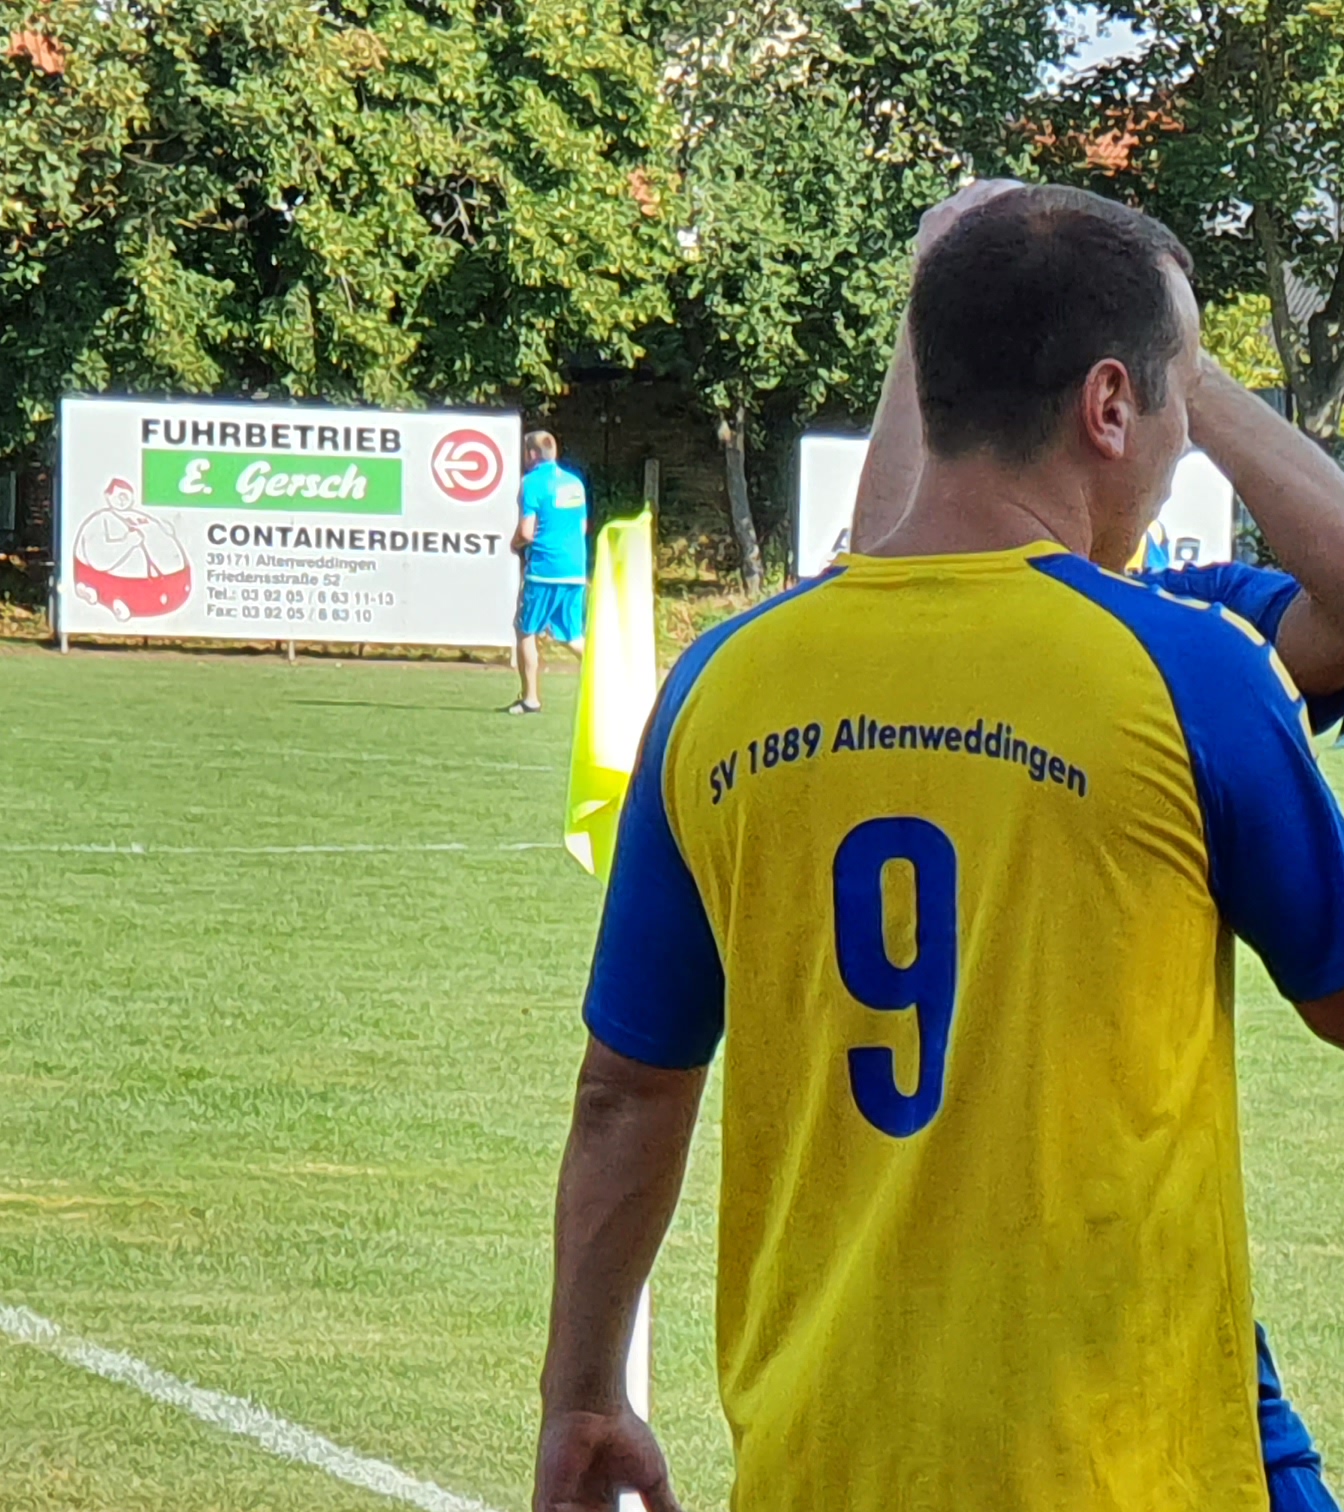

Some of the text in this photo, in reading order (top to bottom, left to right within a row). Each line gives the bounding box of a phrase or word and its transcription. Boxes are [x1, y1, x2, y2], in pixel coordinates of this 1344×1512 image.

[141, 418, 401, 453] FUHRBETRIEB
[178, 458, 369, 504] E. Gersch
[207, 523, 502, 555] CONTAINERDIENST
[710, 713, 1087, 805] SV 1889 Altenweddingen
[833, 815, 957, 1138] 9
